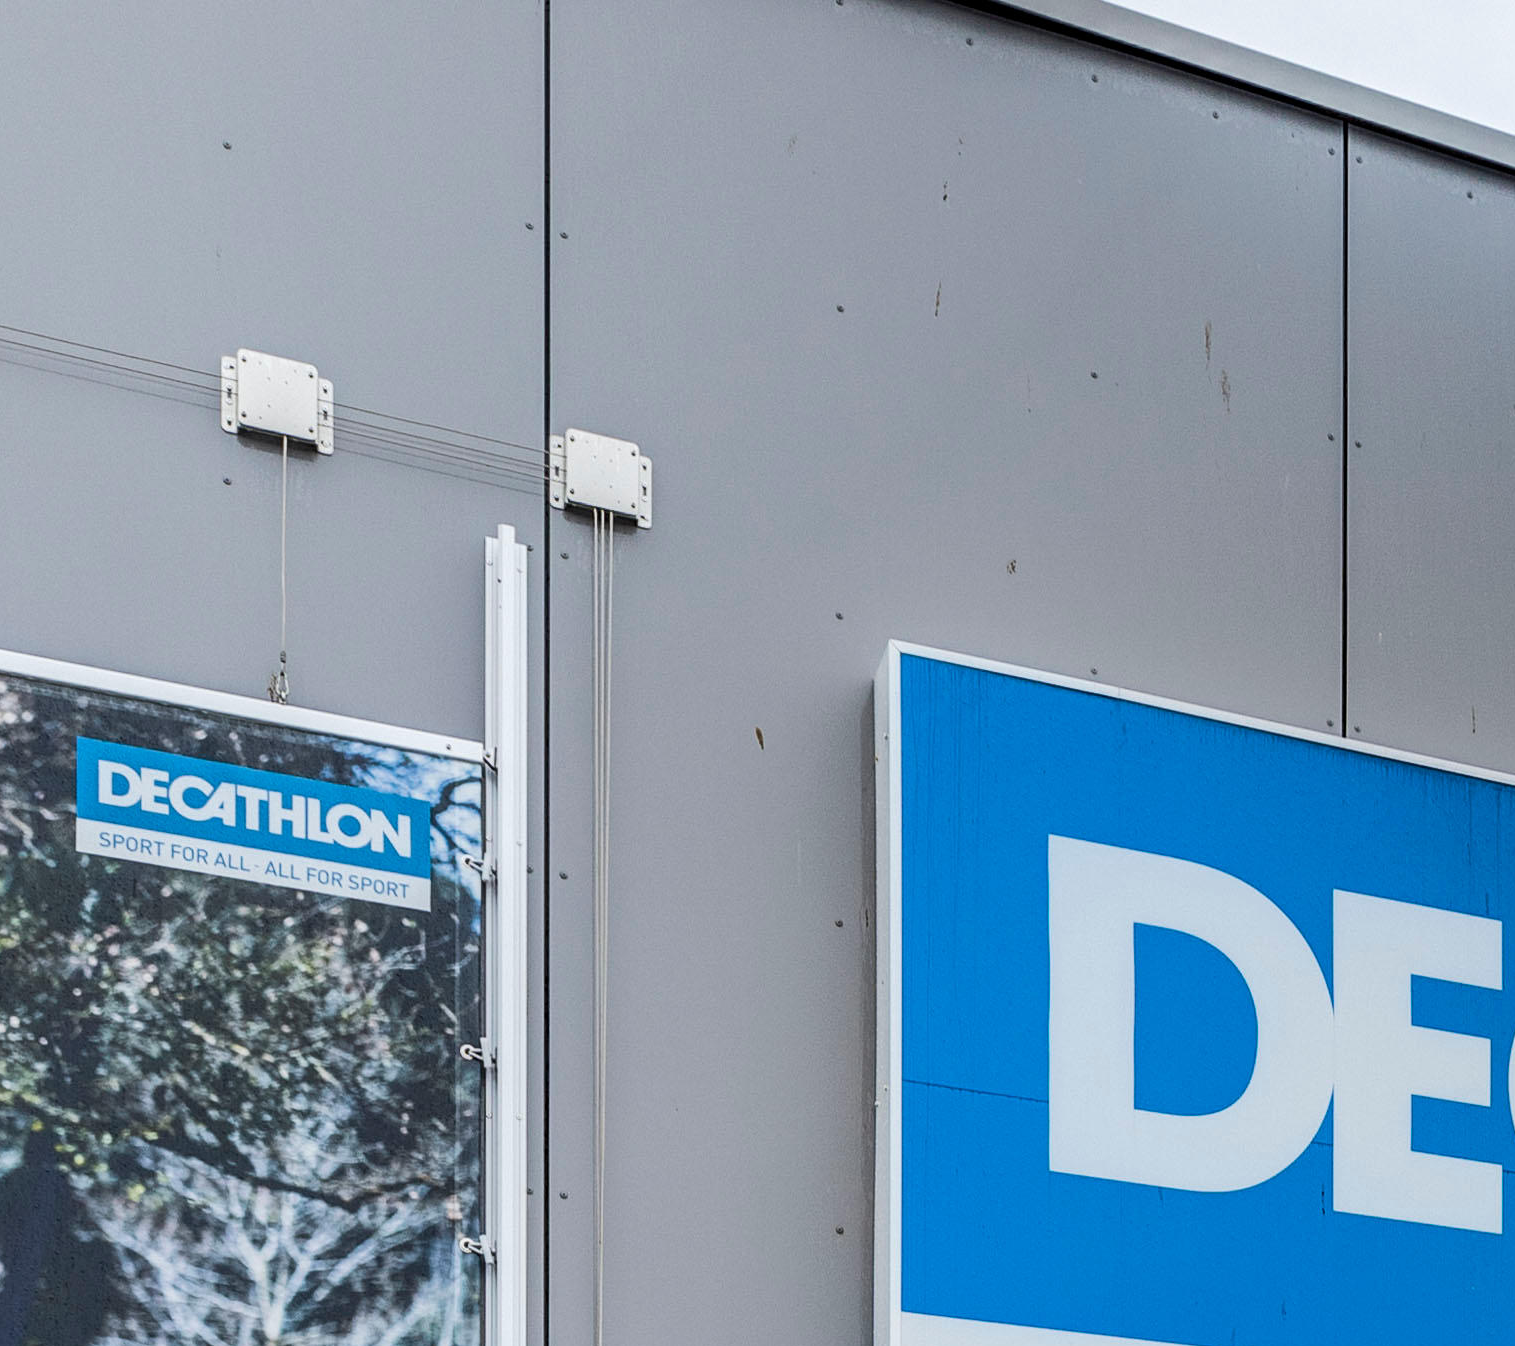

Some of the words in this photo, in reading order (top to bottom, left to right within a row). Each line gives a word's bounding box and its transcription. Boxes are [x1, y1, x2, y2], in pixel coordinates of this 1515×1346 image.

[98, 760, 411, 858] DECATHLON
[99, 832, 165, 857] SPORT
[171, 843, 208, 864] FOR
[214, 852, 251, 872] ALL
[264, 861, 301, 880] ALL
[306, 867, 343, 887] FOR
[348, 874, 410, 899] SPORT
